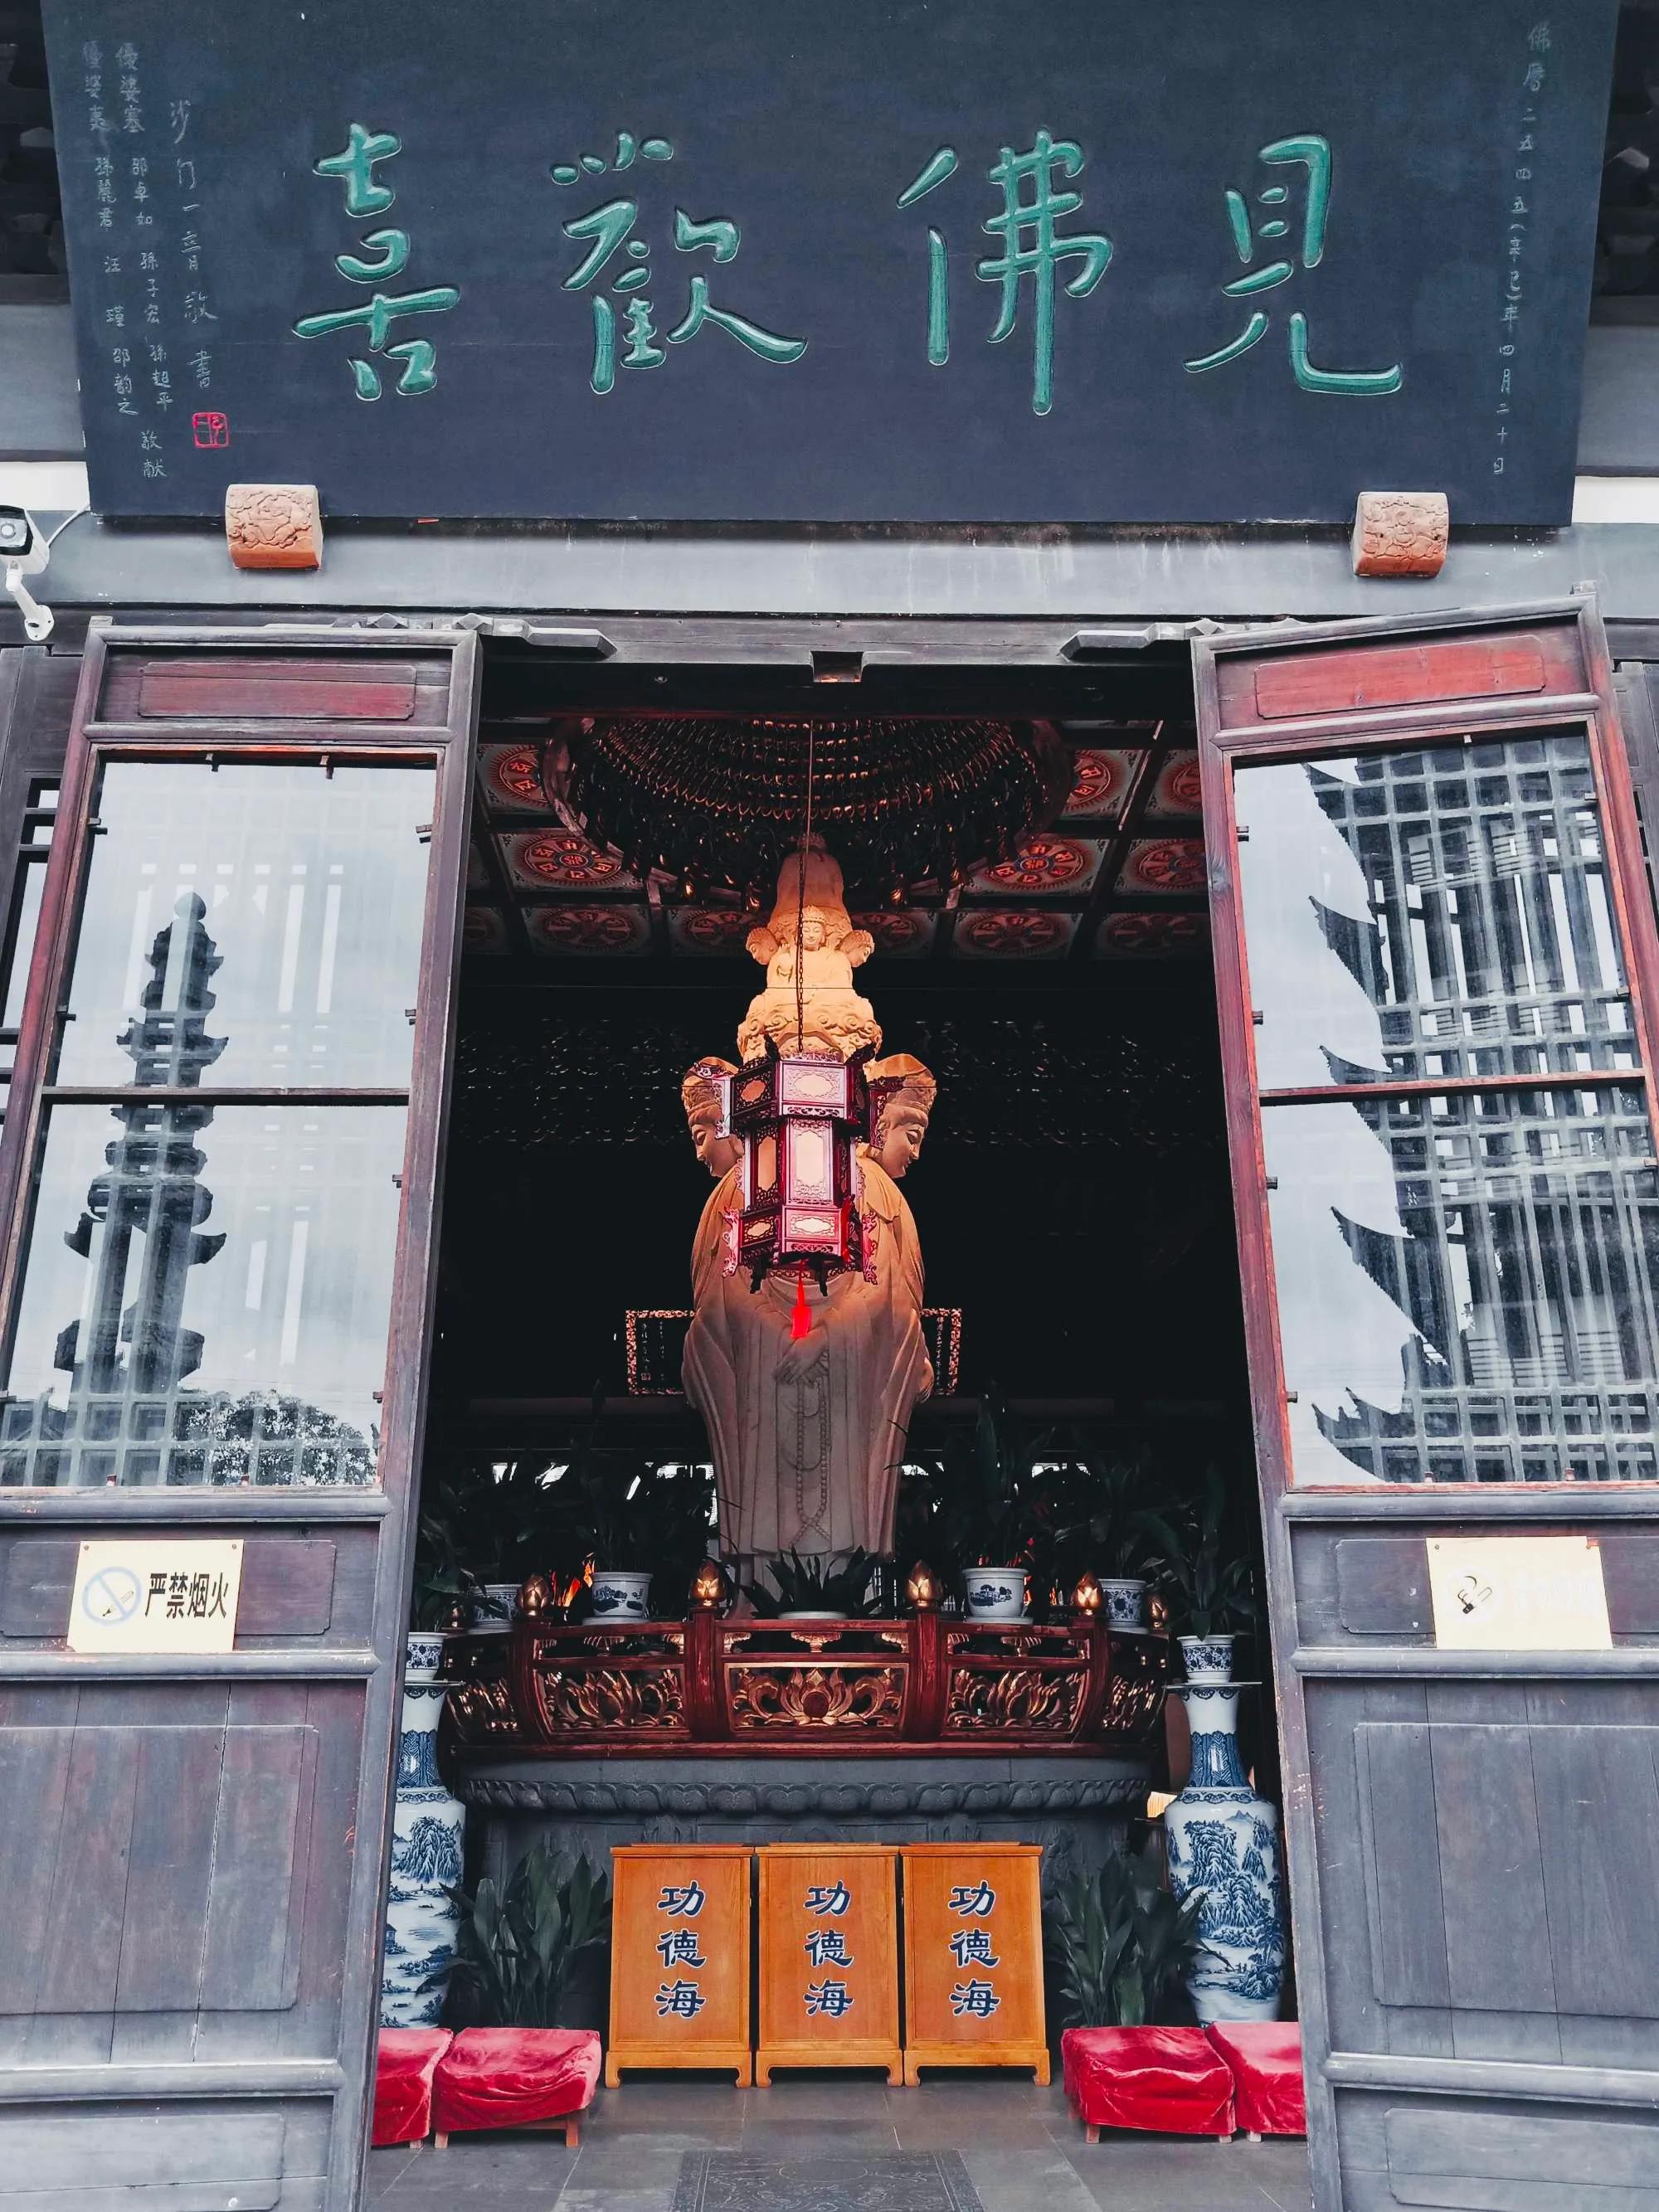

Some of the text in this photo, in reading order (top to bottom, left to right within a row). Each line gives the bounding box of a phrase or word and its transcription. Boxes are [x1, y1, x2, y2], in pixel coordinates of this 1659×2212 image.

[144, 1572, 229, 1619] 严禁烟火
[655, 1879, 707, 2019] 功德海
[803, 1879, 854, 2019] 功德海
[948, 1879, 1000, 2019] 功德海
